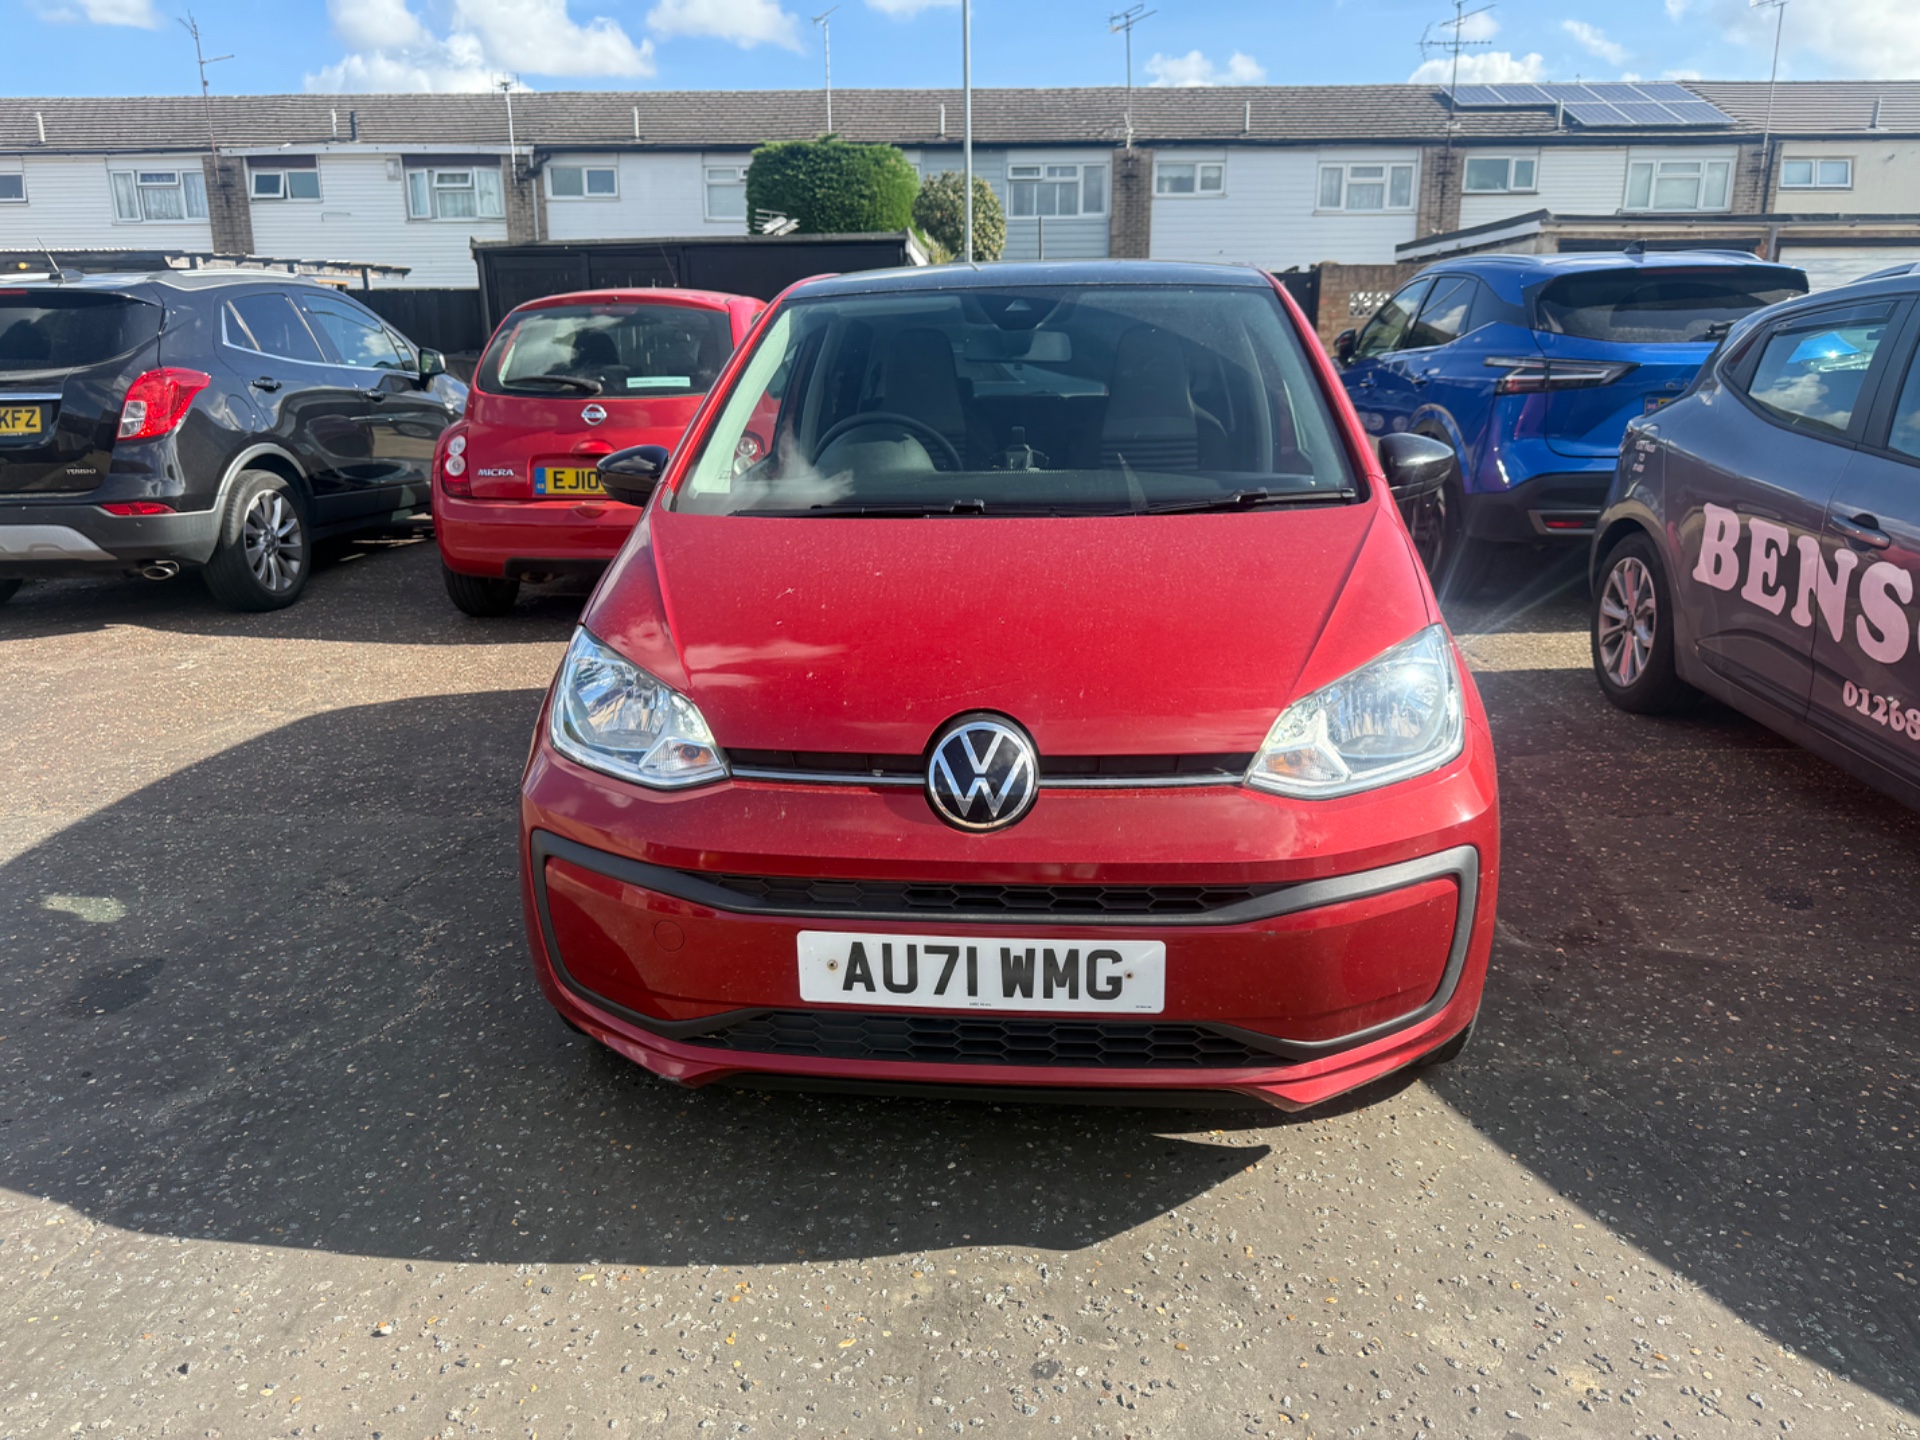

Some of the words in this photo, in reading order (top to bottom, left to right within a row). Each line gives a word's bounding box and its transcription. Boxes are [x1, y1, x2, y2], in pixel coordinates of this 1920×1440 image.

[477, 468, 515, 477] MICRA
[1692, 502, 1920, 664] BENS
[935, 729, 1026, 818] VW
[842, 941, 978, 997] AU71
[1000, 947, 1124, 1001] WMG
